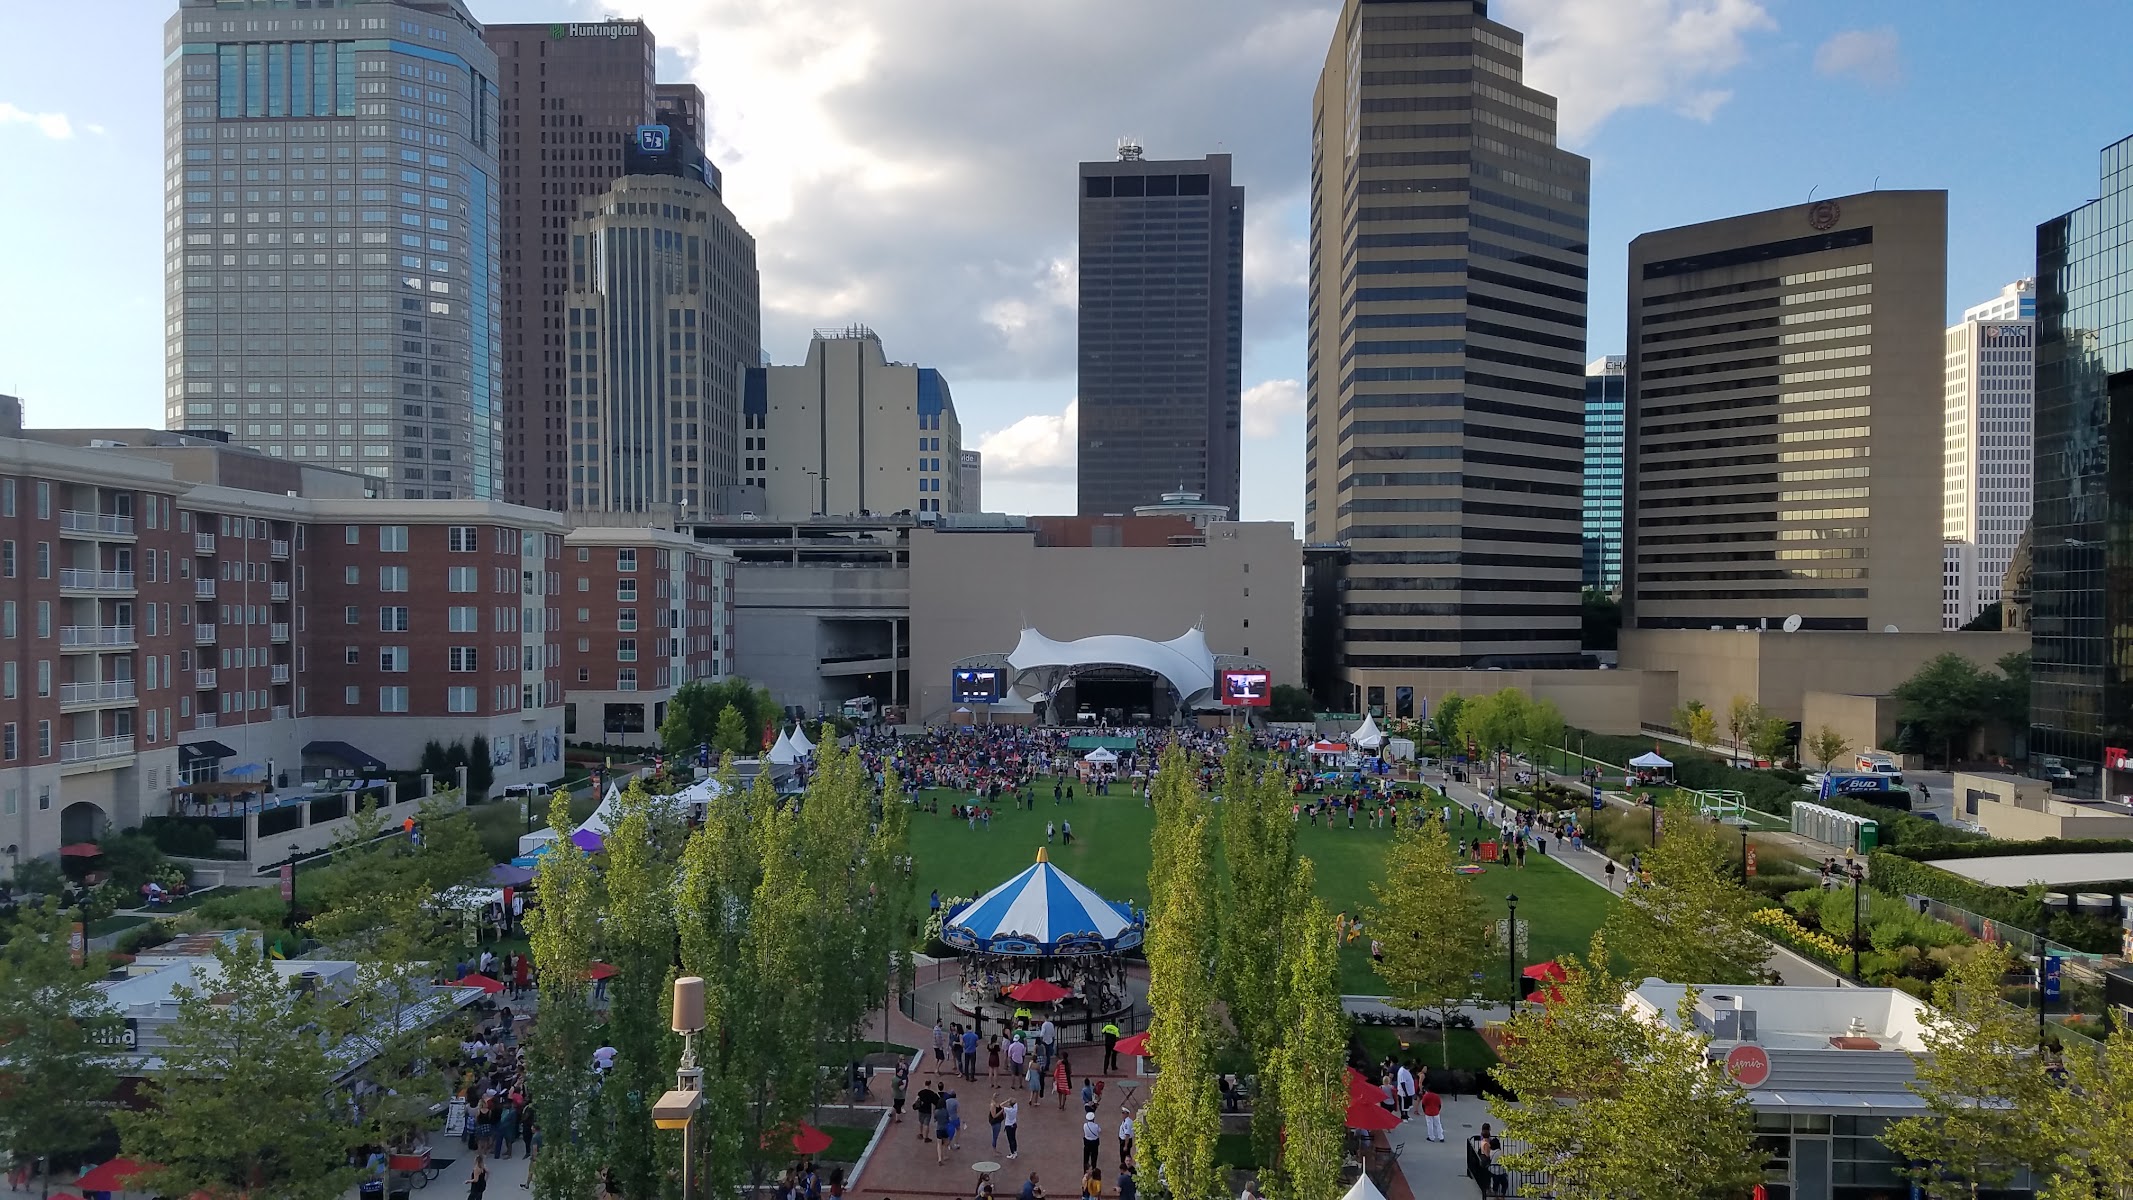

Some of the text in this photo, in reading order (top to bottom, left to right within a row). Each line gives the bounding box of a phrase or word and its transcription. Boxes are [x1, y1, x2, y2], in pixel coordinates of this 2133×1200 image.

[569, 23, 638, 39] Huntington
[2000, 327, 2026, 336] PNC
[1849, 780, 1878, 788] BUD
